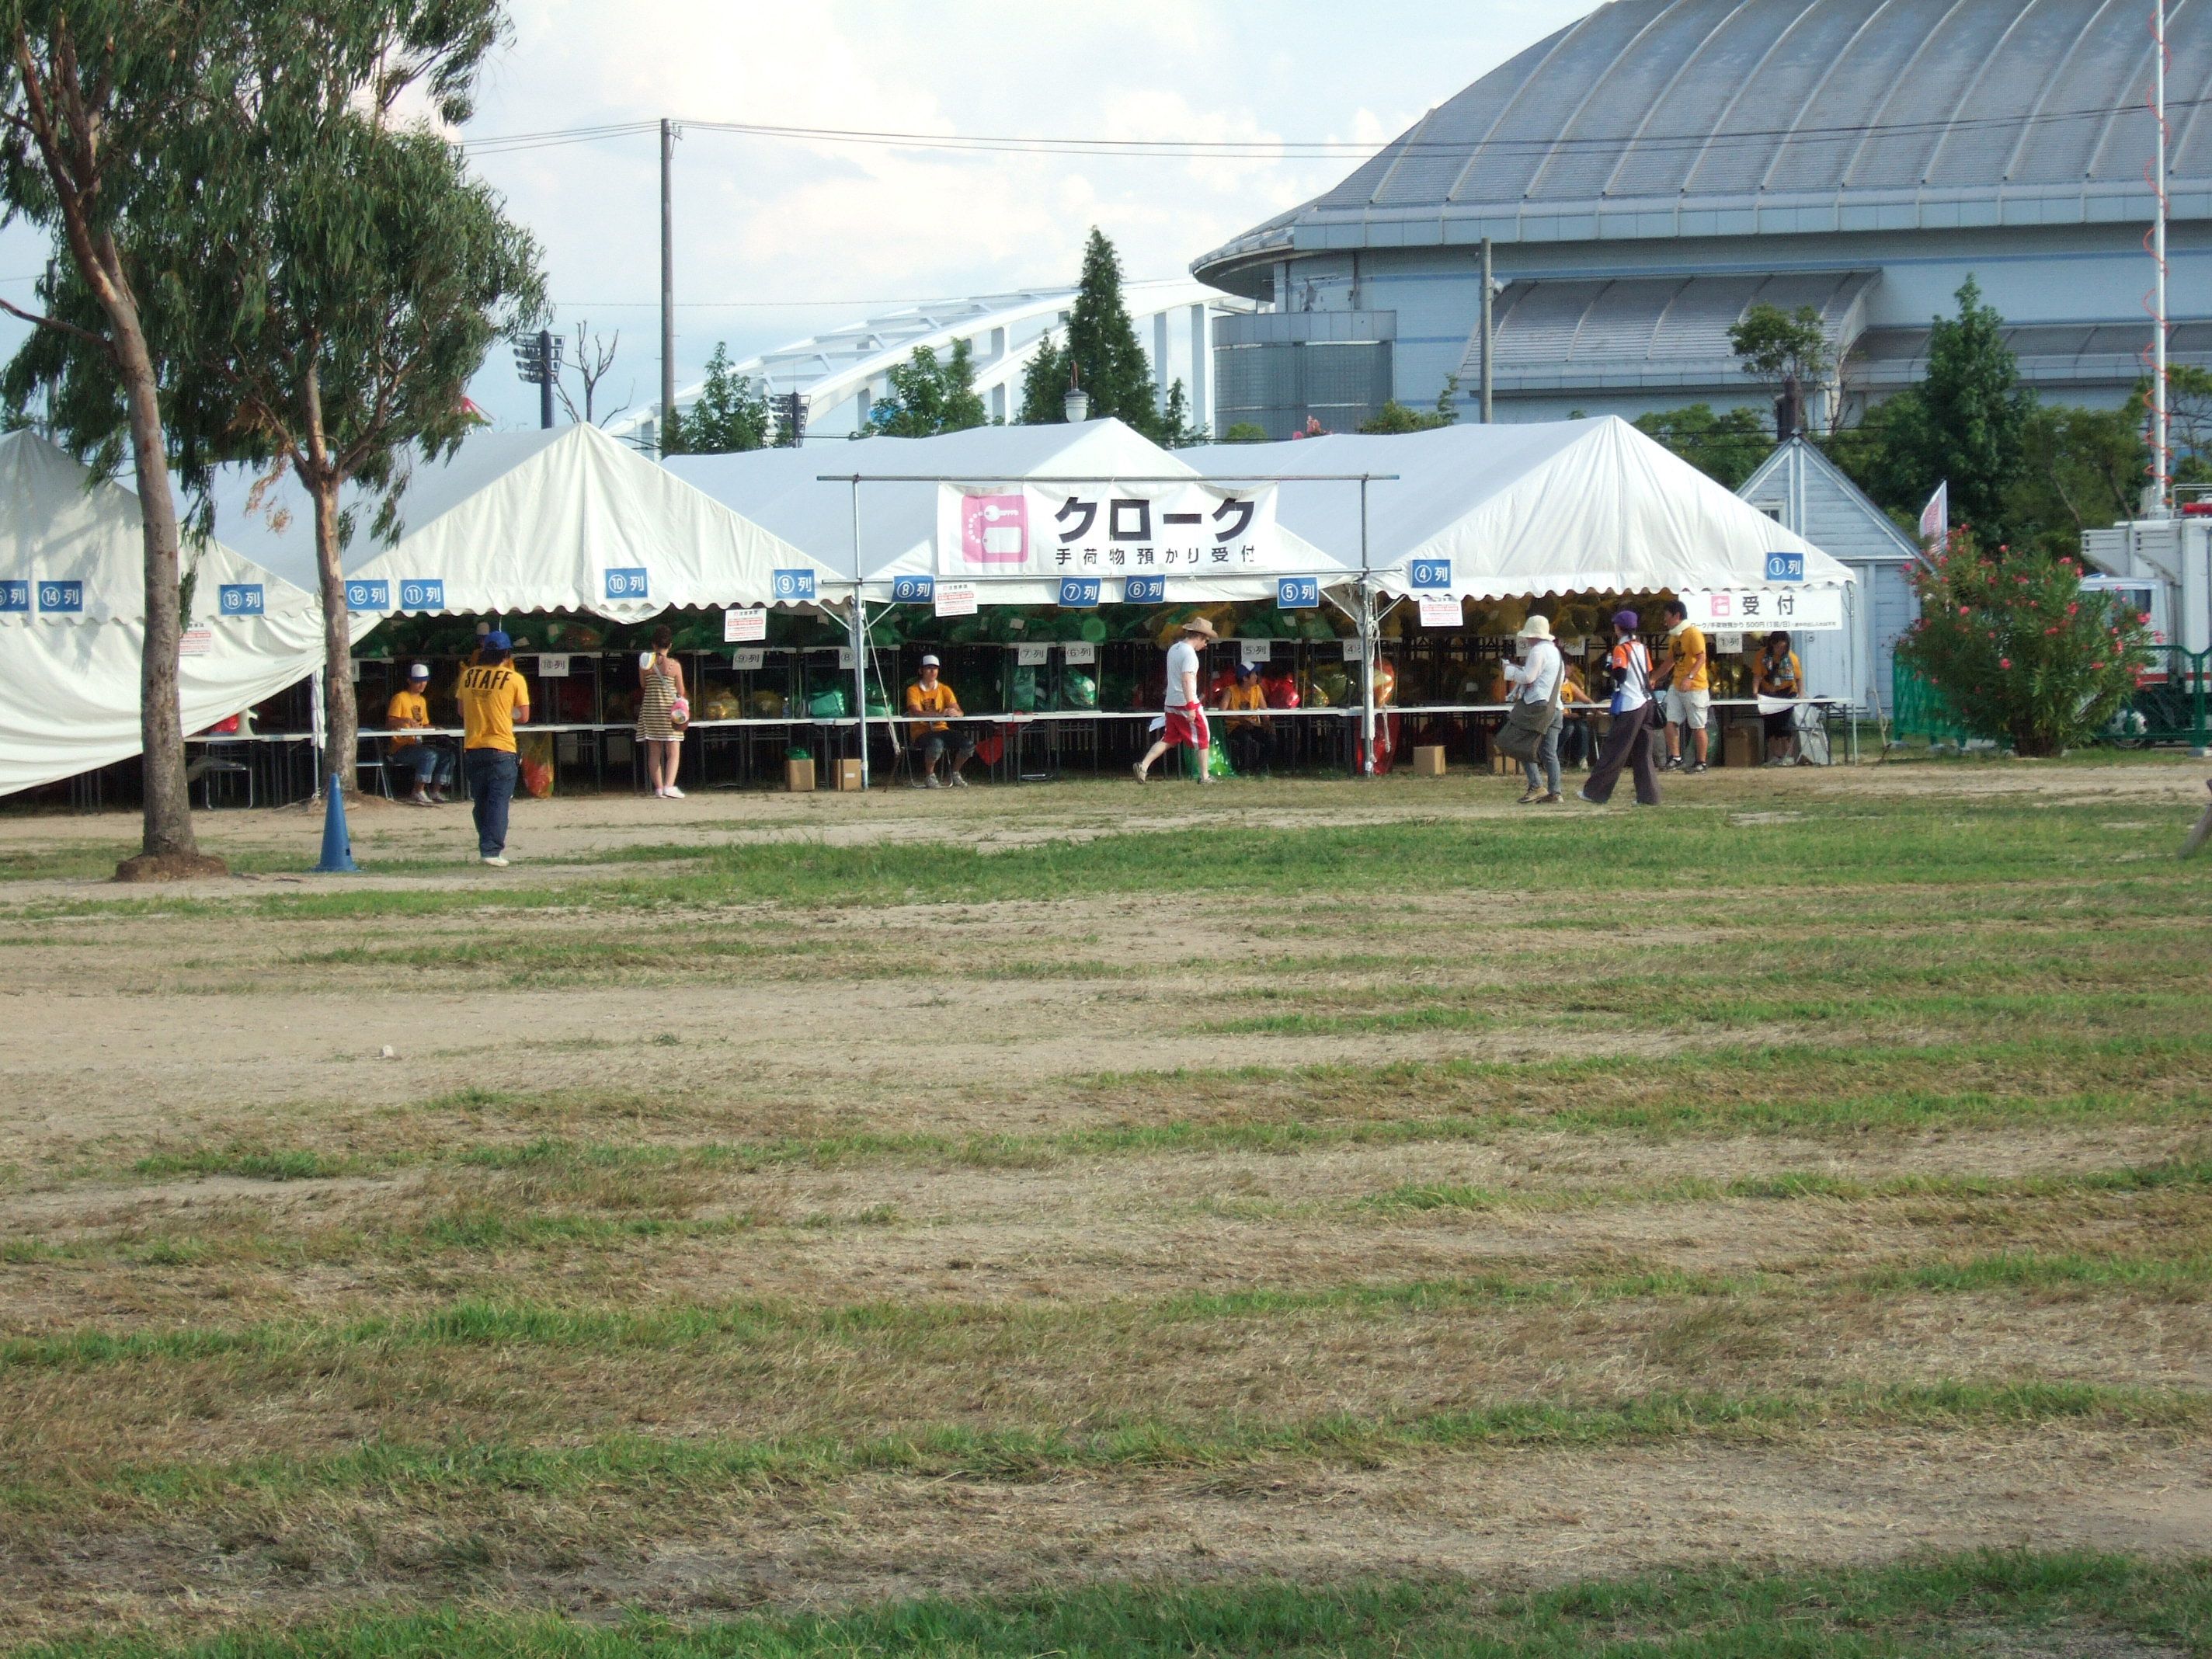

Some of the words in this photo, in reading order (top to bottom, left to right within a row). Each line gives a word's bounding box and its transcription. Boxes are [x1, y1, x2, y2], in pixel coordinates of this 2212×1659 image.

[1055, 496, 1255, 543] クローク
[1056, 545, 1255, 565] 手荷物預かり受付
[1742, 595, 1794, 616] 受付
[464, 668, 513, 690] STAFF
